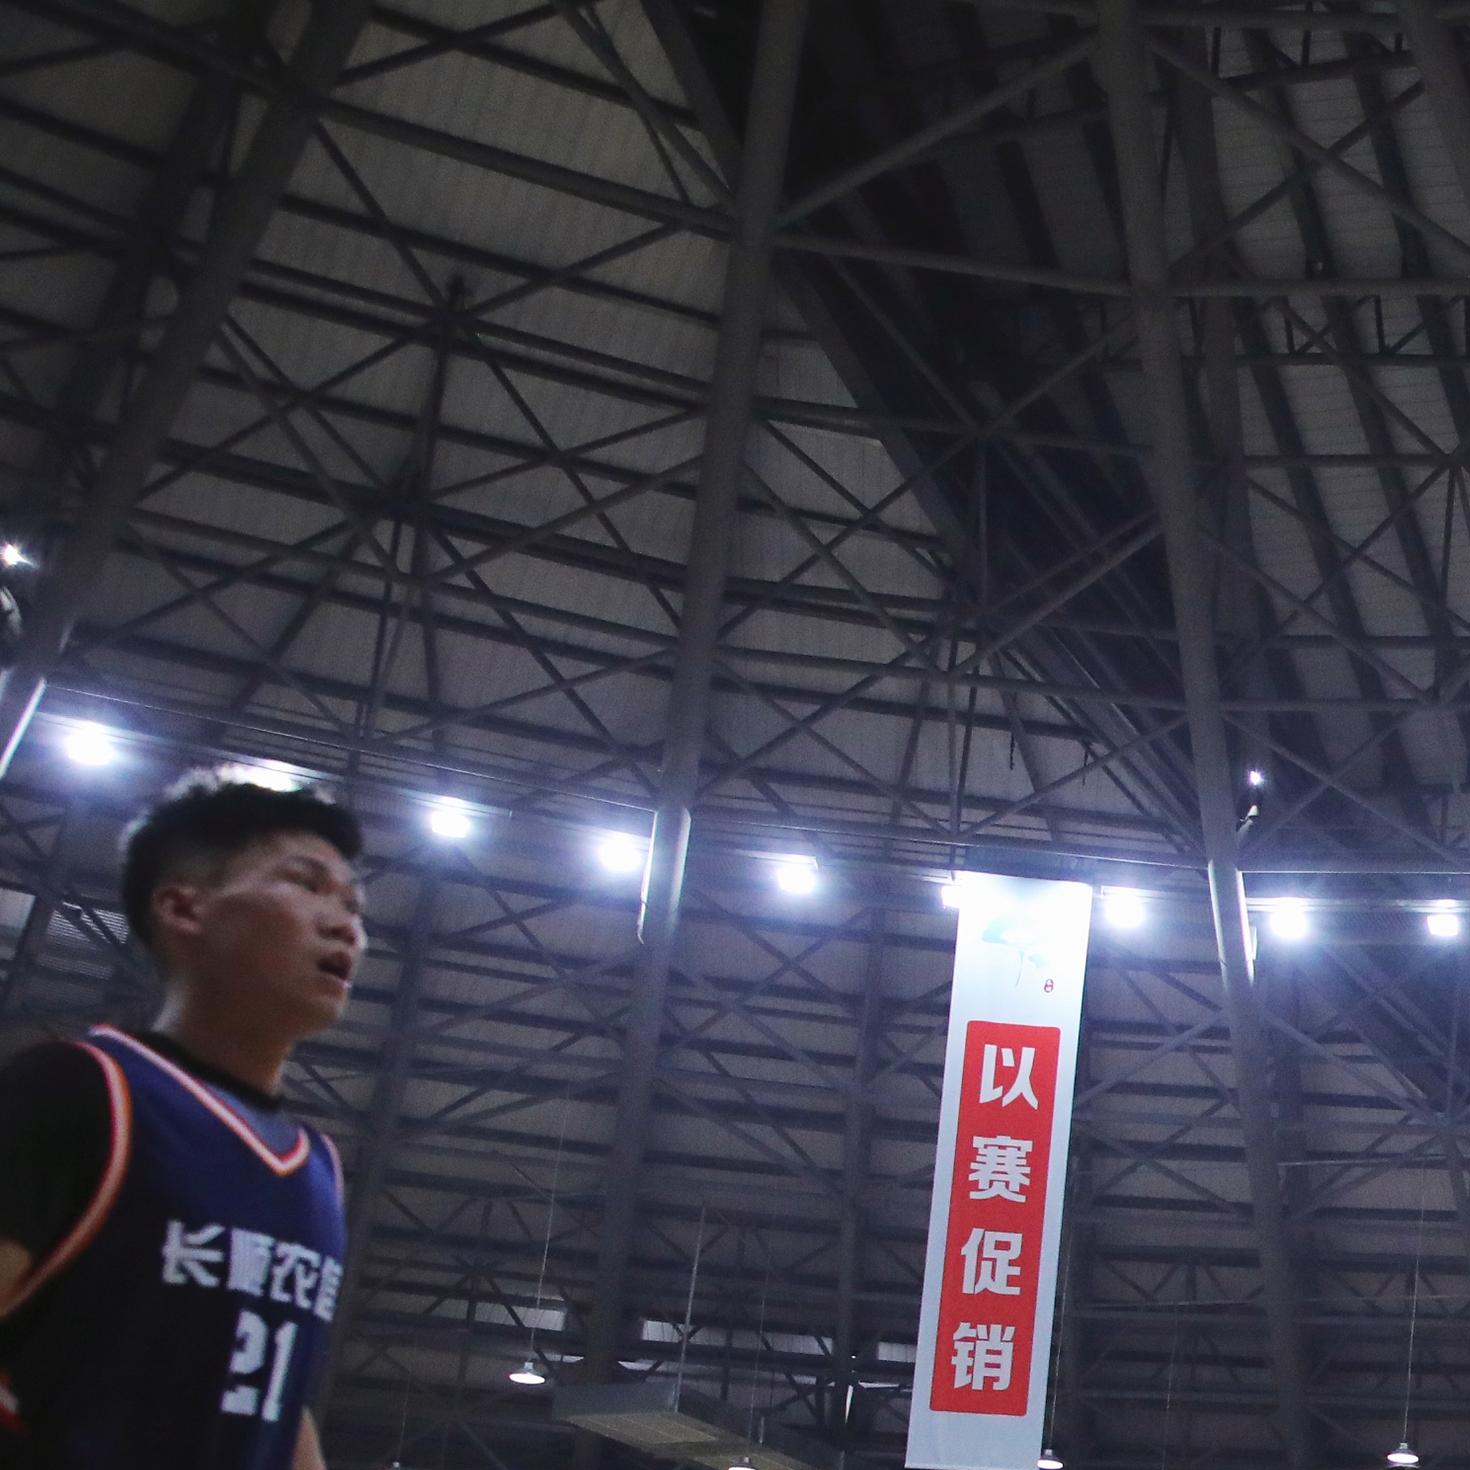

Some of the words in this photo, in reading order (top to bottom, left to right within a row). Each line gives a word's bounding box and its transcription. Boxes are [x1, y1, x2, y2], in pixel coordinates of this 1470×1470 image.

[951, 1043, 1038, 1391] 以赛促销
[220, 1310, 299, 1422] 21
